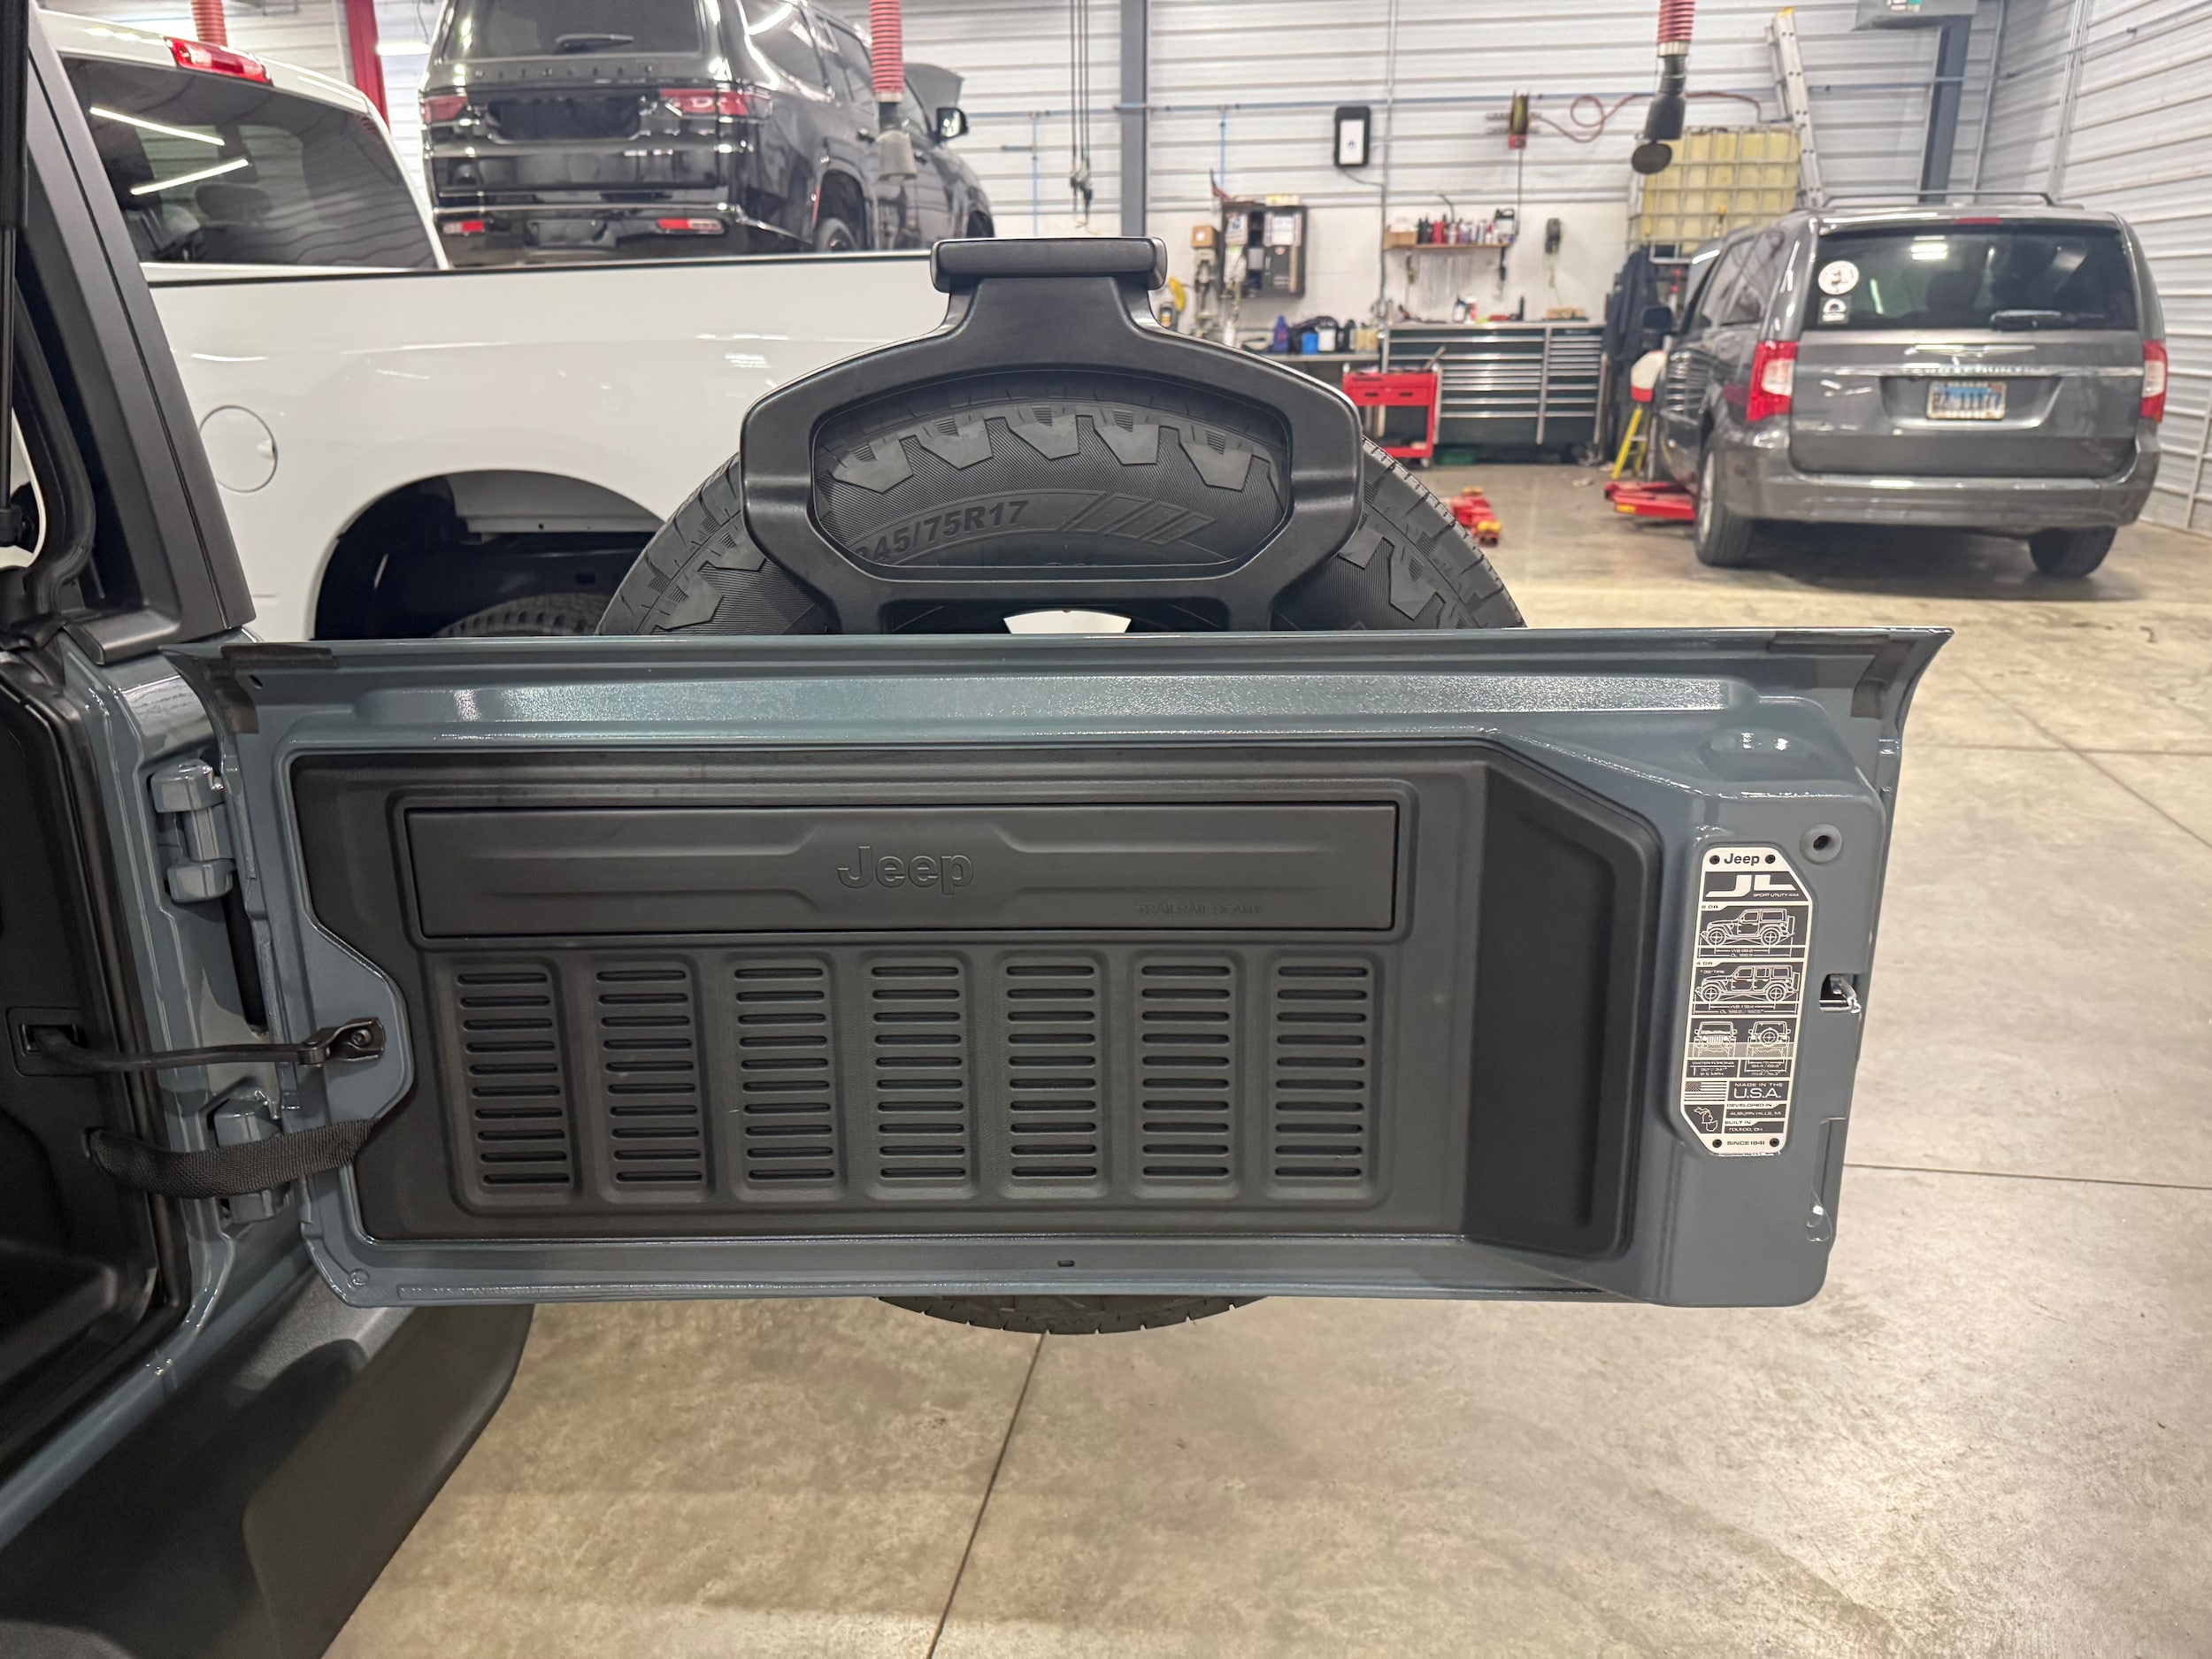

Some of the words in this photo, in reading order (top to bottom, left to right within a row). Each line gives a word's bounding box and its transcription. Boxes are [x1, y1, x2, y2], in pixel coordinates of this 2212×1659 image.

[1724, 853, 1760, 866] Jeep
[837, 846, 973, 895] Jeep
[1705, 874, 1797, 898] JL
[1733, 1087, 1782, 1099] U.S.A.
